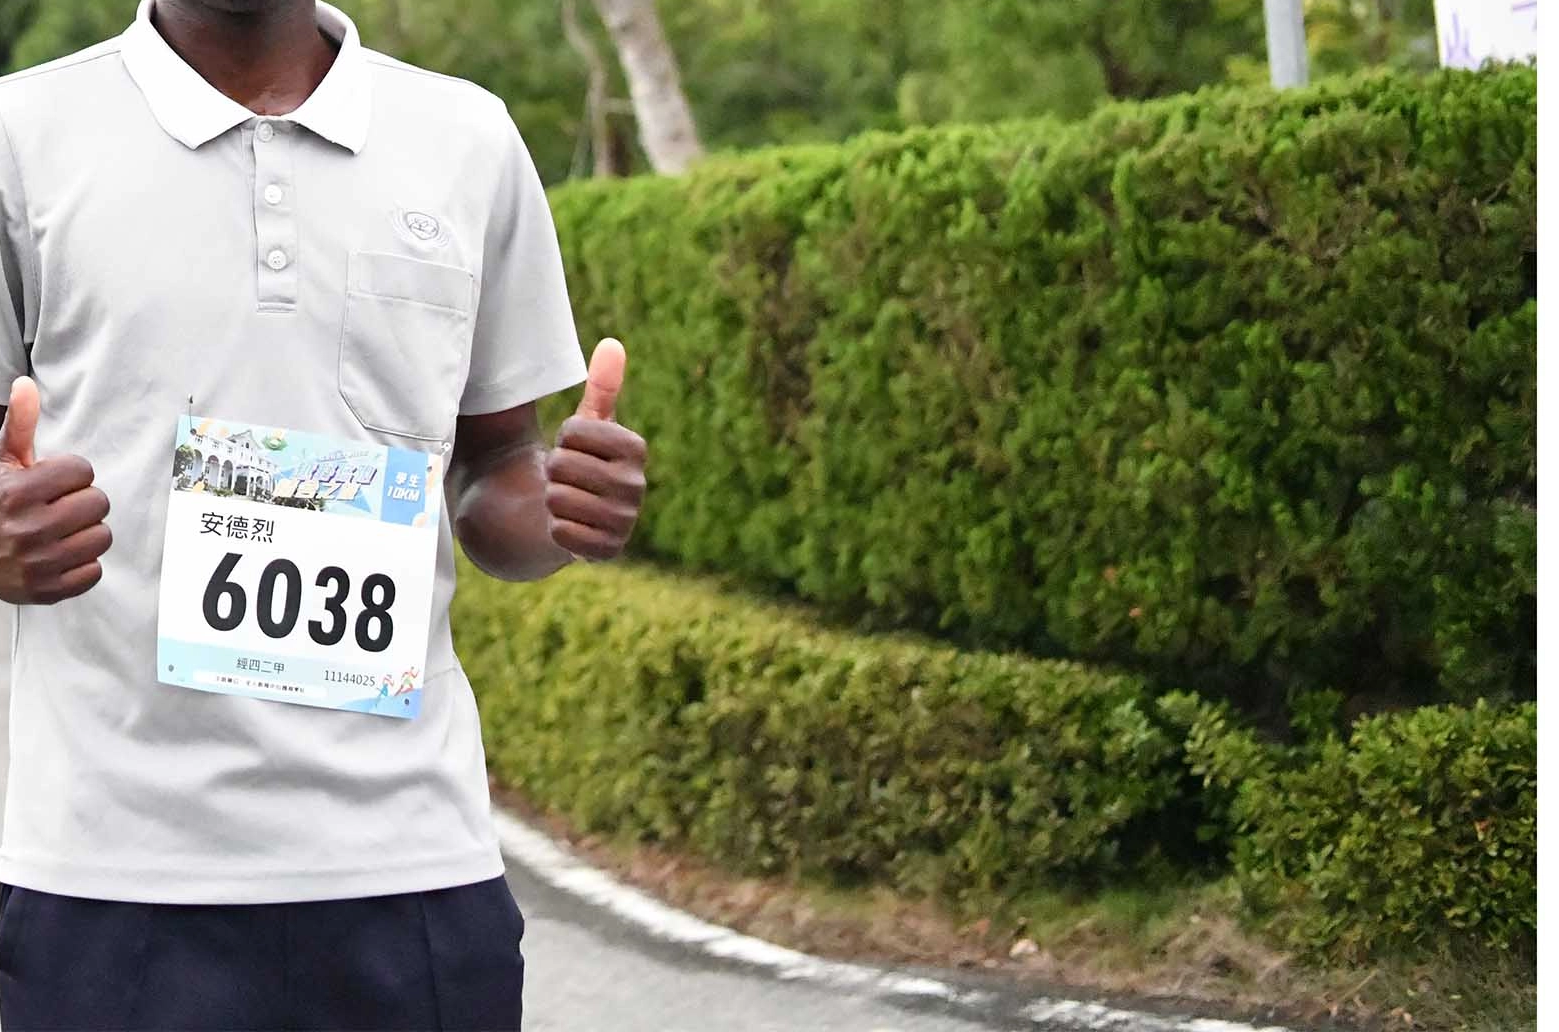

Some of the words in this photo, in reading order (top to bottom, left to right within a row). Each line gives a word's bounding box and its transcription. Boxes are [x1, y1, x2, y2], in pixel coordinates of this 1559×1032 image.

[387, 485, 421, 503] 10KM
[200, 511, 276, 545] 安德烈
[201, 551, 397, 654] 6038
[235, 656, 285, 674] 經四二甲
[324, 669, 376, 687] 11144025
